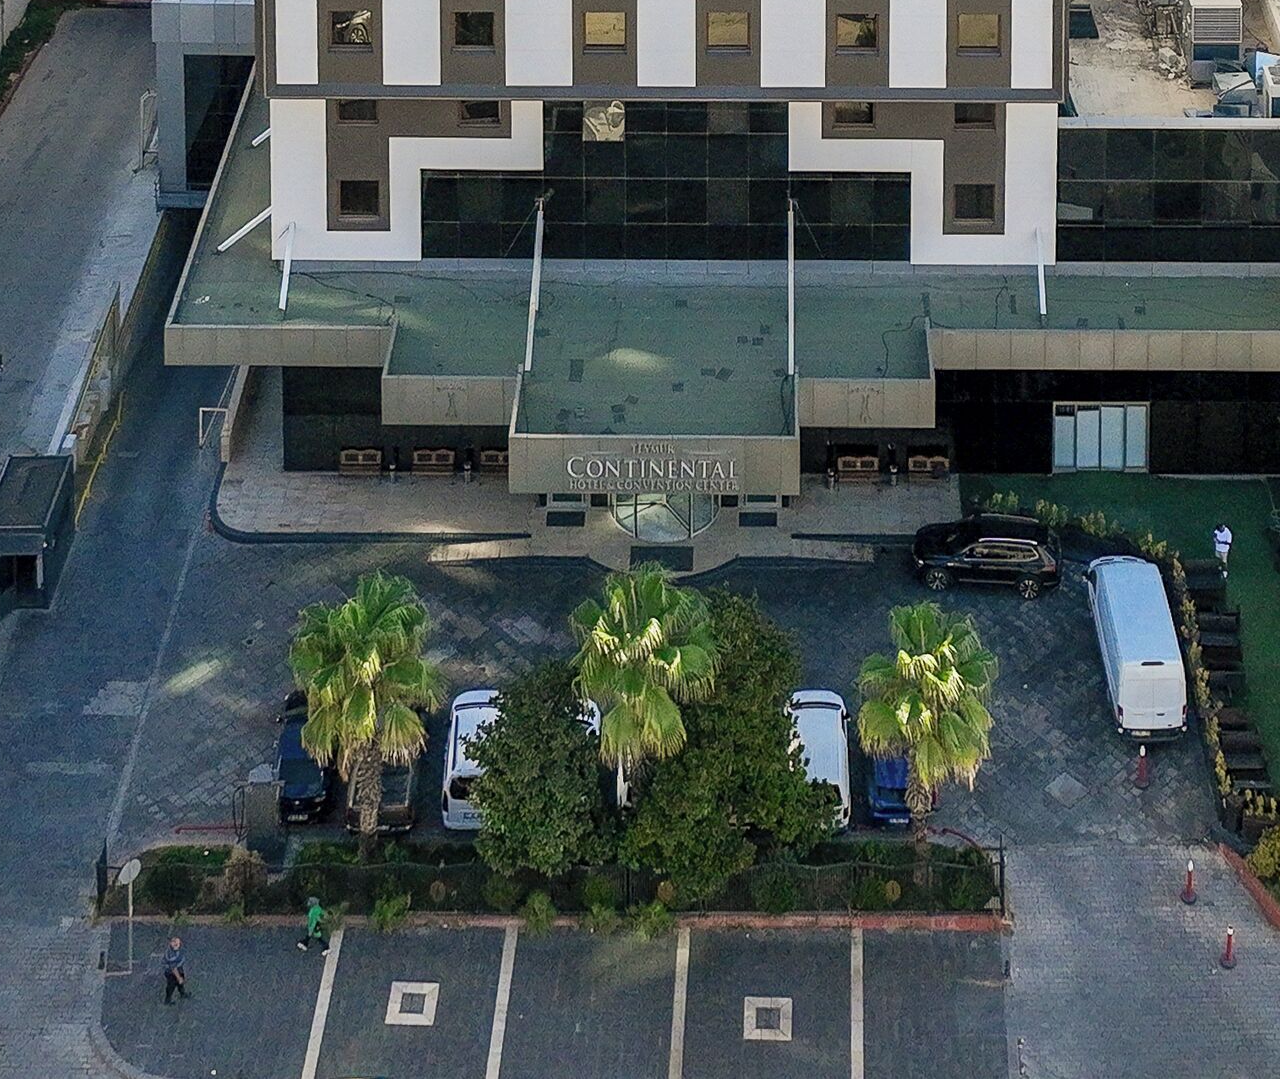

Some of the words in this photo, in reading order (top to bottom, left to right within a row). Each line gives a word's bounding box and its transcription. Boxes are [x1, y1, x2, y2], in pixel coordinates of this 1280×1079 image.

[566, 456, 739, 479] CONTINENTAL
[569, 479, 605, 491] HOTEL
[616, 479, 692, 491] CONVENTION
[695, 479, 739, 492] CENTER
